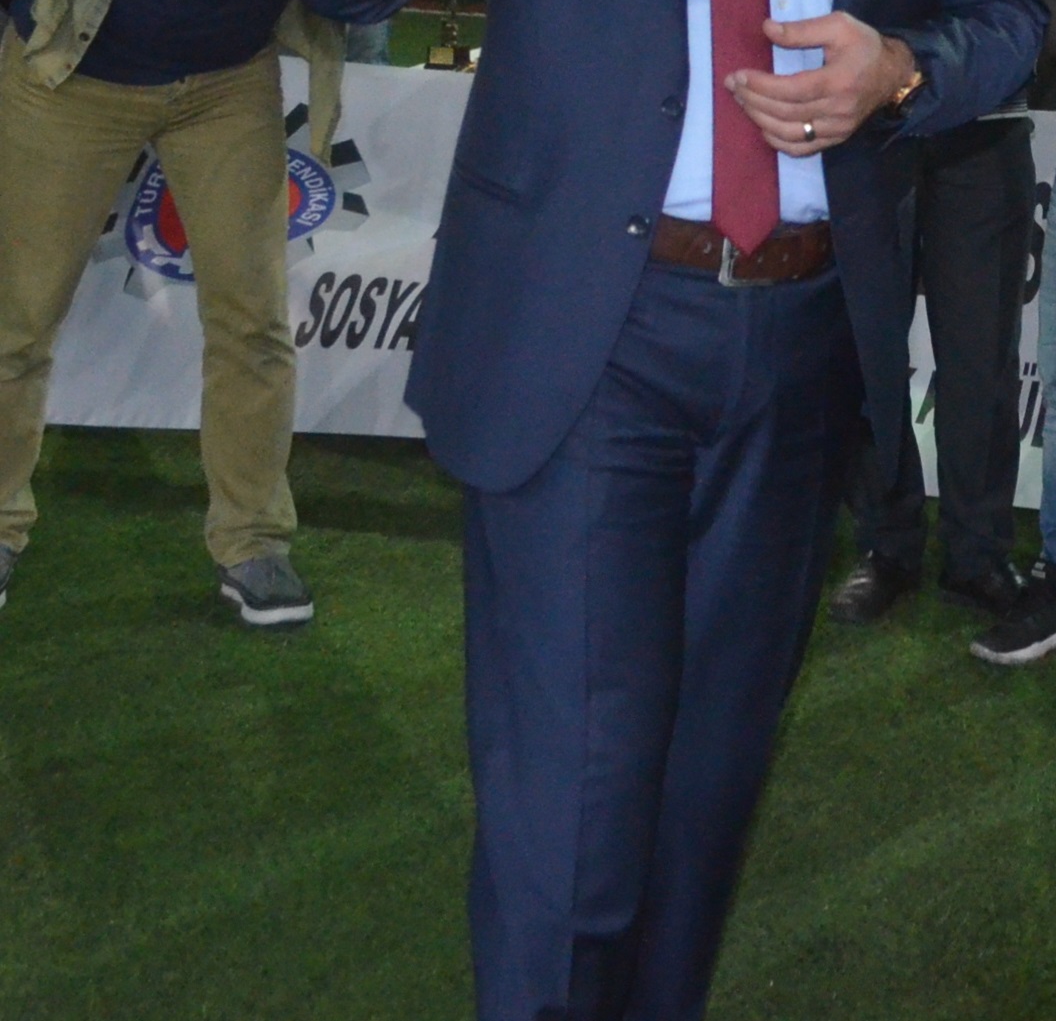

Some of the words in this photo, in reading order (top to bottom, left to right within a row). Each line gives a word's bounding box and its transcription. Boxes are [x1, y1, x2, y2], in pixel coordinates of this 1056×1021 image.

[134, 164, 166, 218] TÜR
[286, 154, 331, 226] ENDİKASI
[294, 271, 425, 351] SOSYA
